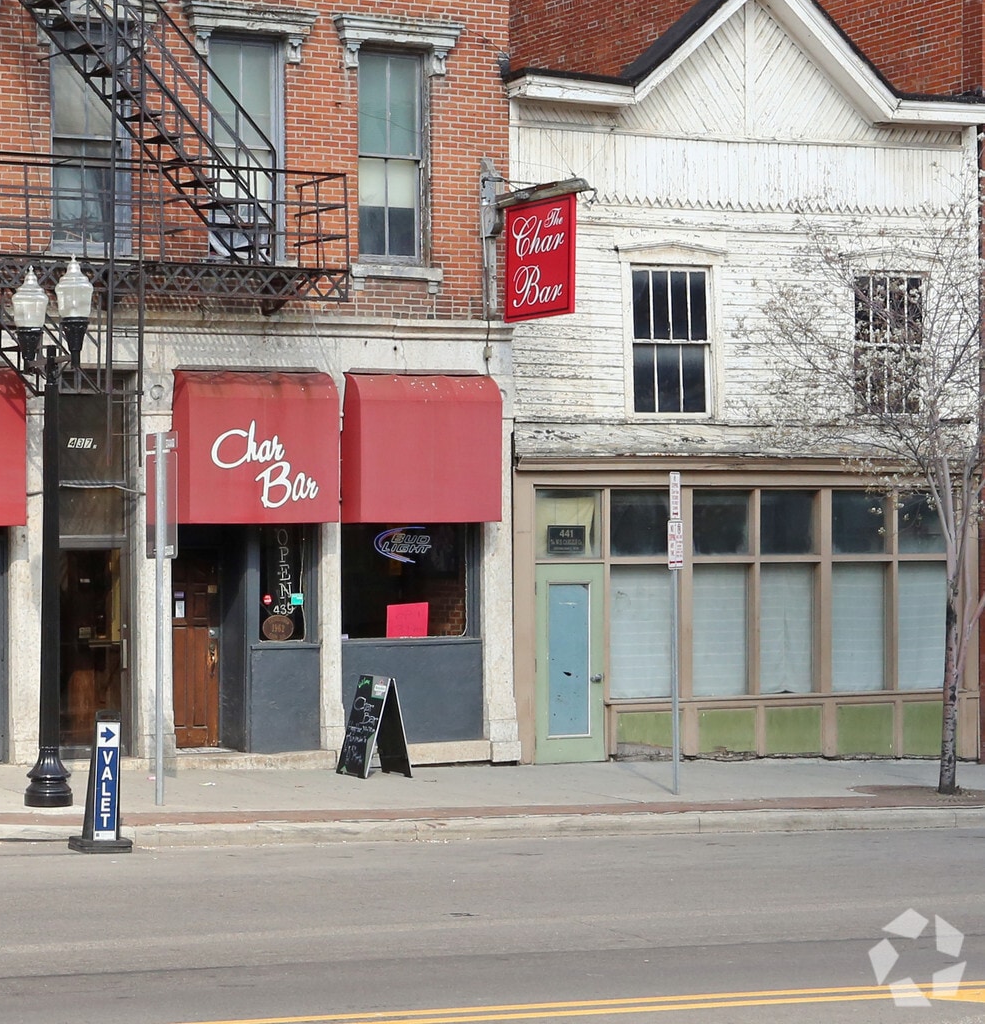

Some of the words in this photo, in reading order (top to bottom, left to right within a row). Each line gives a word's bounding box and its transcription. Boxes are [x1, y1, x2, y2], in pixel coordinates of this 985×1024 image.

[512, 215, 565, 260] Char
[543, 207, 564, 228] The
[512, 264, 564, 309] Bar
[210, 419, 286, 469] Char
[254, 460, 319, 509] Bar
[559, 529, 574, 538] 441
[277, 528, 292, 599] OPEN
[273, 603, 295, 615] 439
[100, 750, 114, 828] VALET
